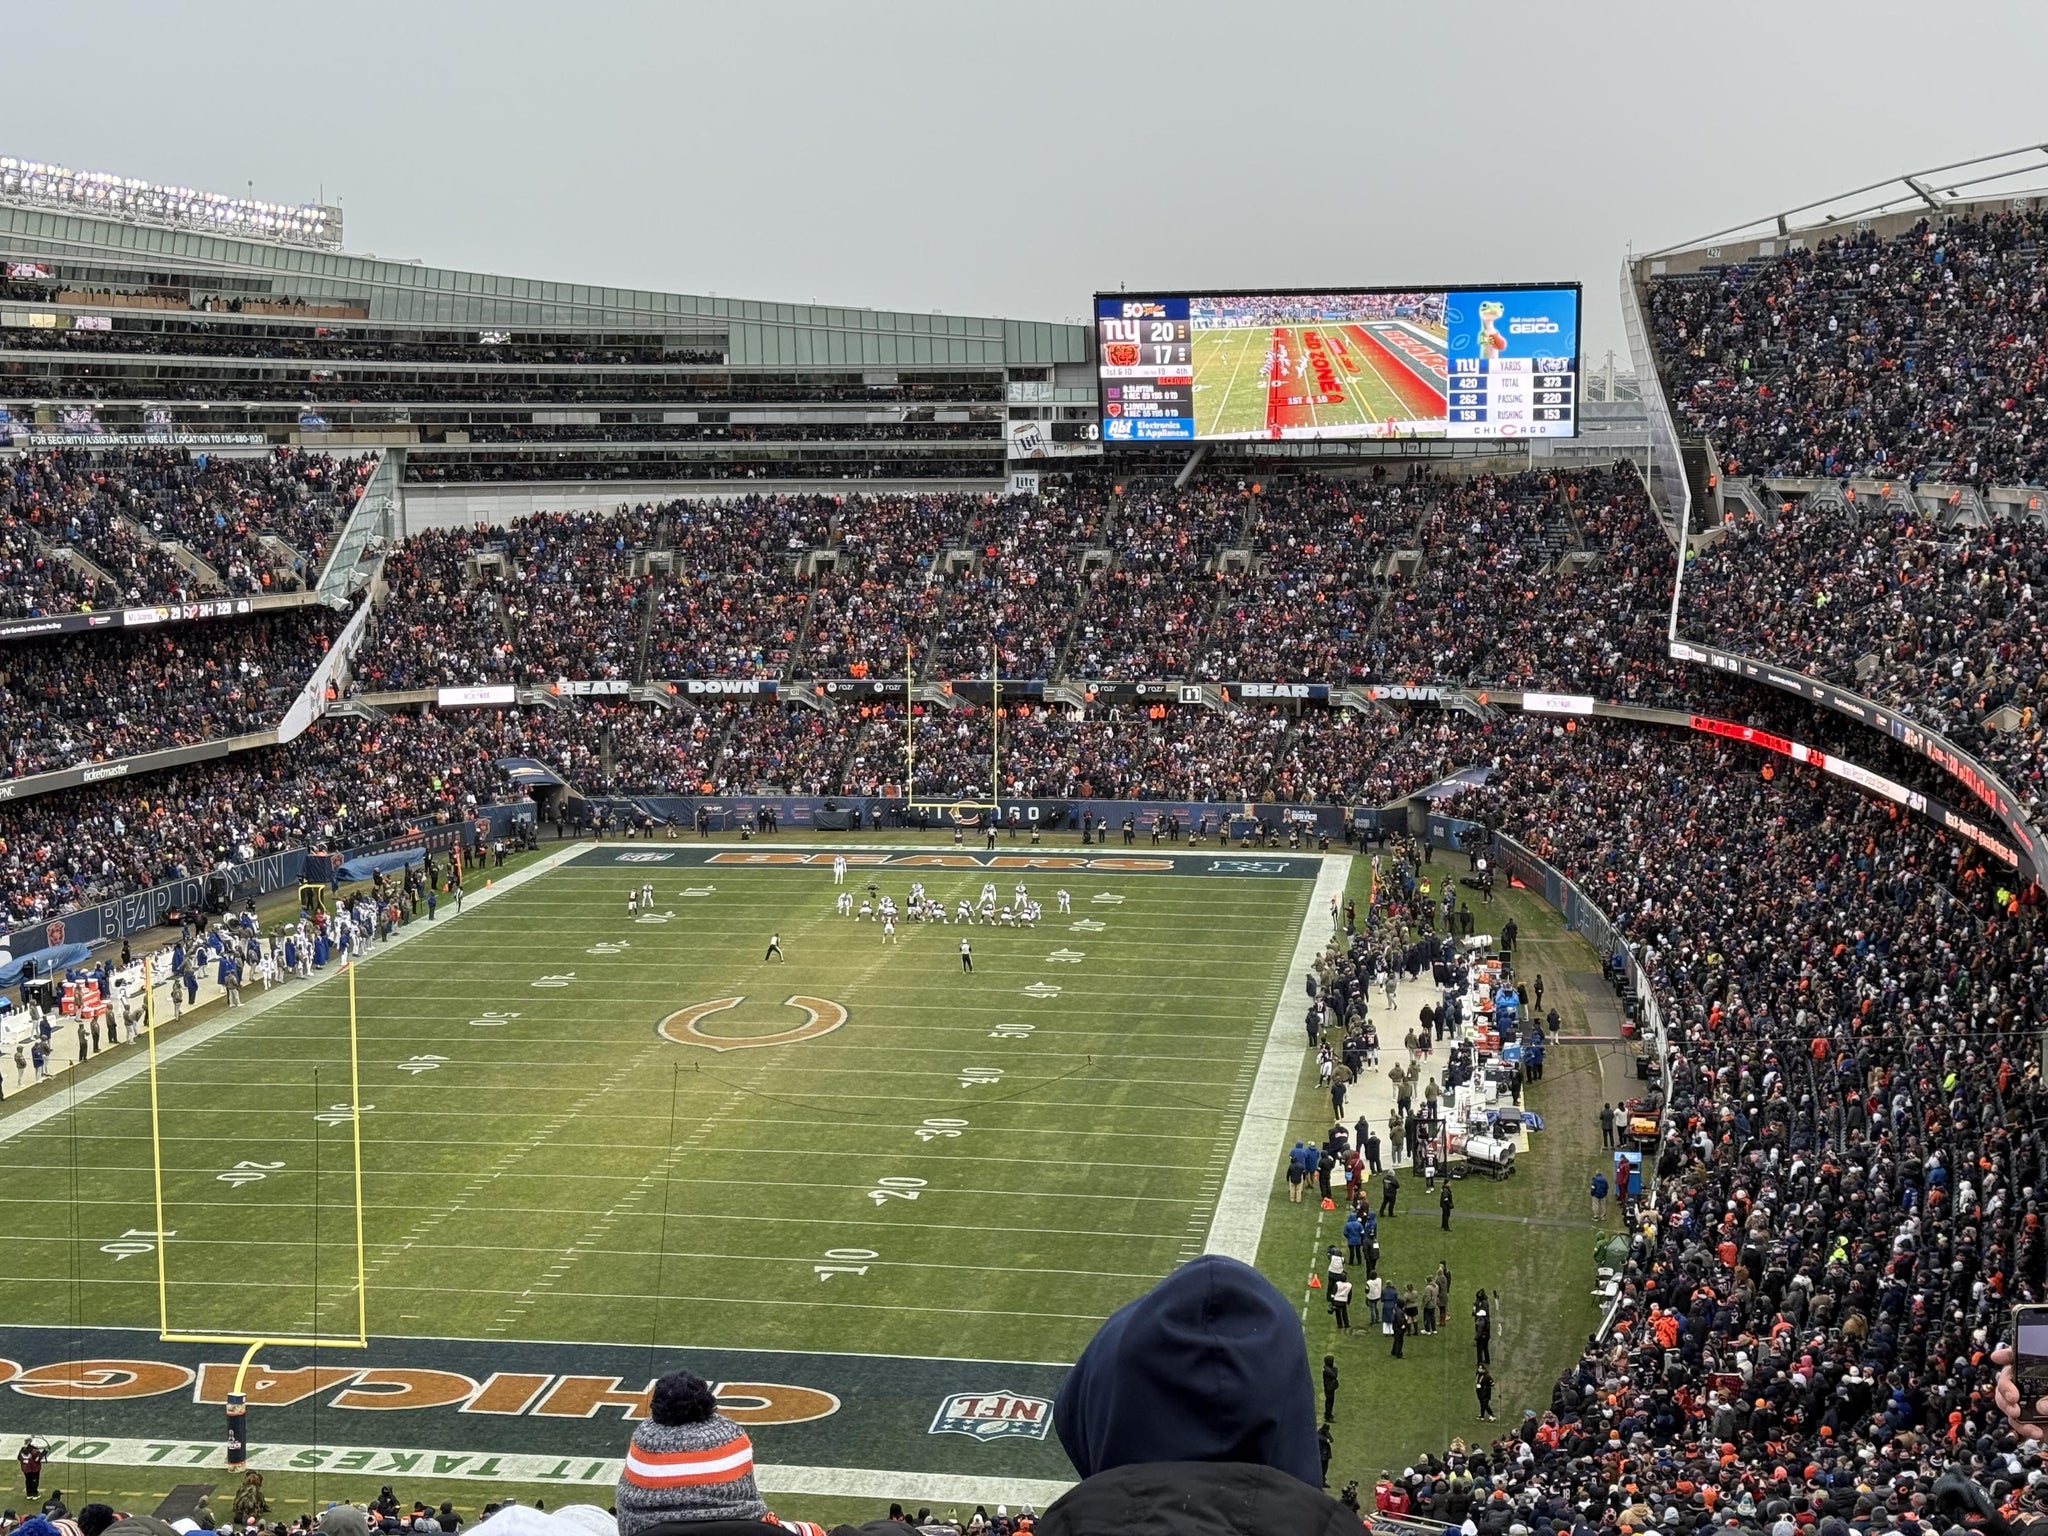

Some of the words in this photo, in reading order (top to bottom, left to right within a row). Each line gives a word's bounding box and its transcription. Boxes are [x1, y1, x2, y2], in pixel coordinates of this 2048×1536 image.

[1151, 321, 1174, 341] 20
[1509, 323, 1559, 334] GEICO
[1153, 345, 1172, 365] 17
[1175, 367, 1188, 375] 4th
[1459, 378, 1478, 389] 420
[1502, 378, 1519, 387] TOTAL
[1543, 376, 1561, 388] 373
[1459, 394, 1478, 404] 262
[1498, 395, 1523, 403] PASSING
[1542, 392, 1561, 404] 220
[1497, 410, 1523, 419] RUSHING
[1109, 420, 1133, 434] Abt
[1137, 421, 1181, 429] Electronics
[1474, 424, 1546, 436] CHICAGO
[30, 436, 47, 445] FOR
[129, 435, 146, 444] TEXT
[174, 435, 210, 444] LOCATION
[210, 435, 220, 444] TO
[1145, 429, 1190, 438] Appliances
[1016, 476, 1035, 489] Lite
[171, 607, 181, 620] 29
[558, 682, 630, 694] BEAR
[688, 682, 760, 693] DOWN
[838, 682, 855, 691] razr
[885, 682, 902, 691] razr
[1099, 684, 1117, 692] razr
[1147, 685, 1164, 693] razr
[1241, 684, 1309, 698] BEAR
[1373, 686, 1442, 700] DOWN
[83, 764, 129, 781] ticketmaster
[0, 785, 16, 798] PNC
[704, 852, 1175, 870] BEARS
[1020, 985, 1062, 998] 40
[469, 1012, 522, 1025] 50
[988, 1023, 1036, 1038] 50
[397, 1054, 450, 1070] 40
[957, 1067, 1004, 1083] 40
[314, 1104, 376, 1121] 30
[914, 1118, 969, 1138] 30
[216, 1160, 286, 1182] 20
[867, 1177, 928, 1200] 20
[100, 1229, 178, 1253] 10
[814, 1248, 880, 1275] 10
[0, 1358, 842, 1428] CHICAG
[956, 1395, 1041, 1420] NFL
[1697, 1420, 1708, 1435] 34
[288, 1449, 502, 1477] TAKES
[536, 1458, 605, 1480] IT
